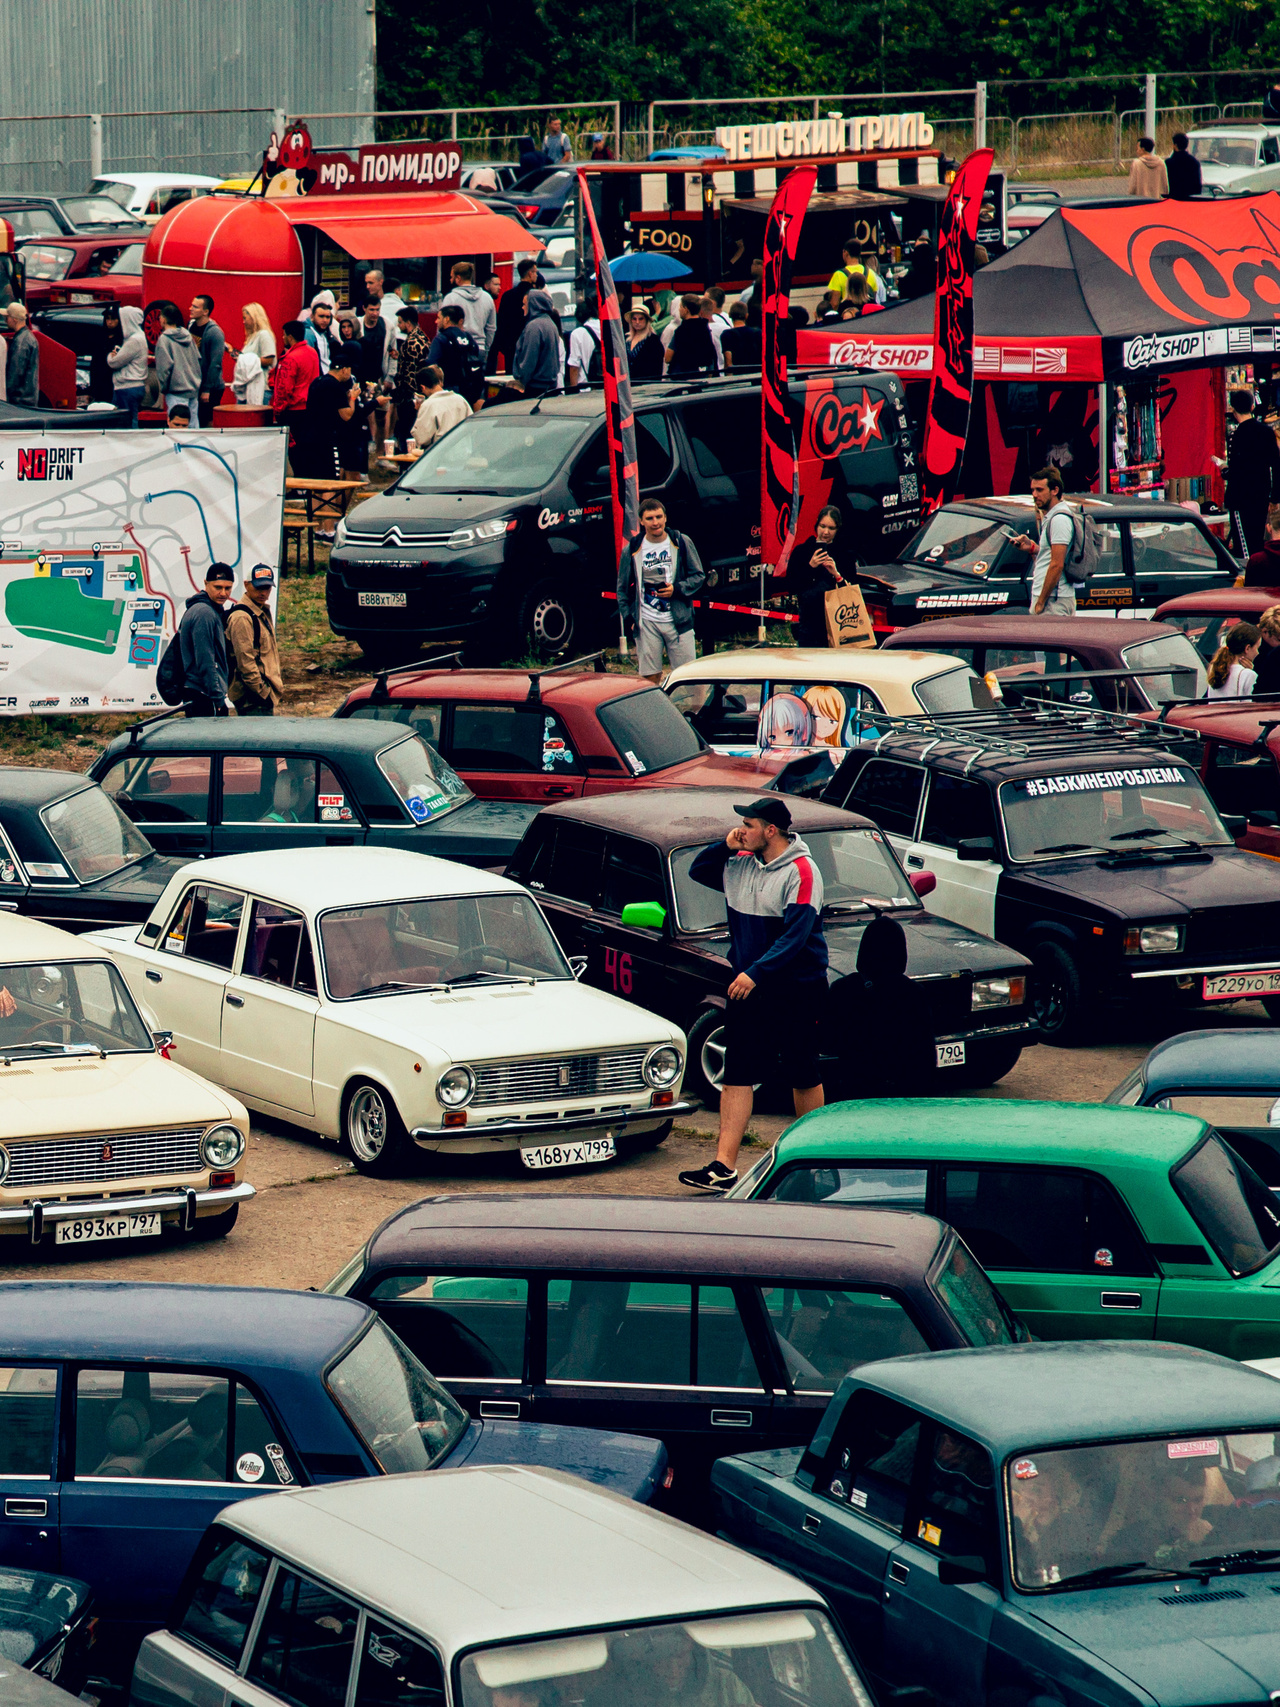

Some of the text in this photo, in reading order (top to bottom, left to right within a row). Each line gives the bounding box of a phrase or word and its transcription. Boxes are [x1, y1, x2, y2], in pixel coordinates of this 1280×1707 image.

[716, 112, 935, 161] ЧЕШСКИЙ ГРИЛЬ
[320, 151, 460, 190] мр. ПОМИДОР
[638, 228, 692, 252] FOOD
[877, 348, 929, 367] SHOP
[1161, 337, 1200, 358] SHOP
[18, 448, 48, 481] NO
[48, 448, 85, 464] DRIFT
[48, 465, 73, 481] FUN
[1076, 597, 1133, 606] RACING
[1026, 767, 1186, 796] #БАБКИНЕПРОБЛЕМА
[319, 796, 343, 805] TILT
[605, 947, 633, 994] 46
[938, 1045, 960, 1060] 790
[526, 1140, 609, 1166] Е168УХ 799
[62, 1214, 156, 1240] К893КР 797
